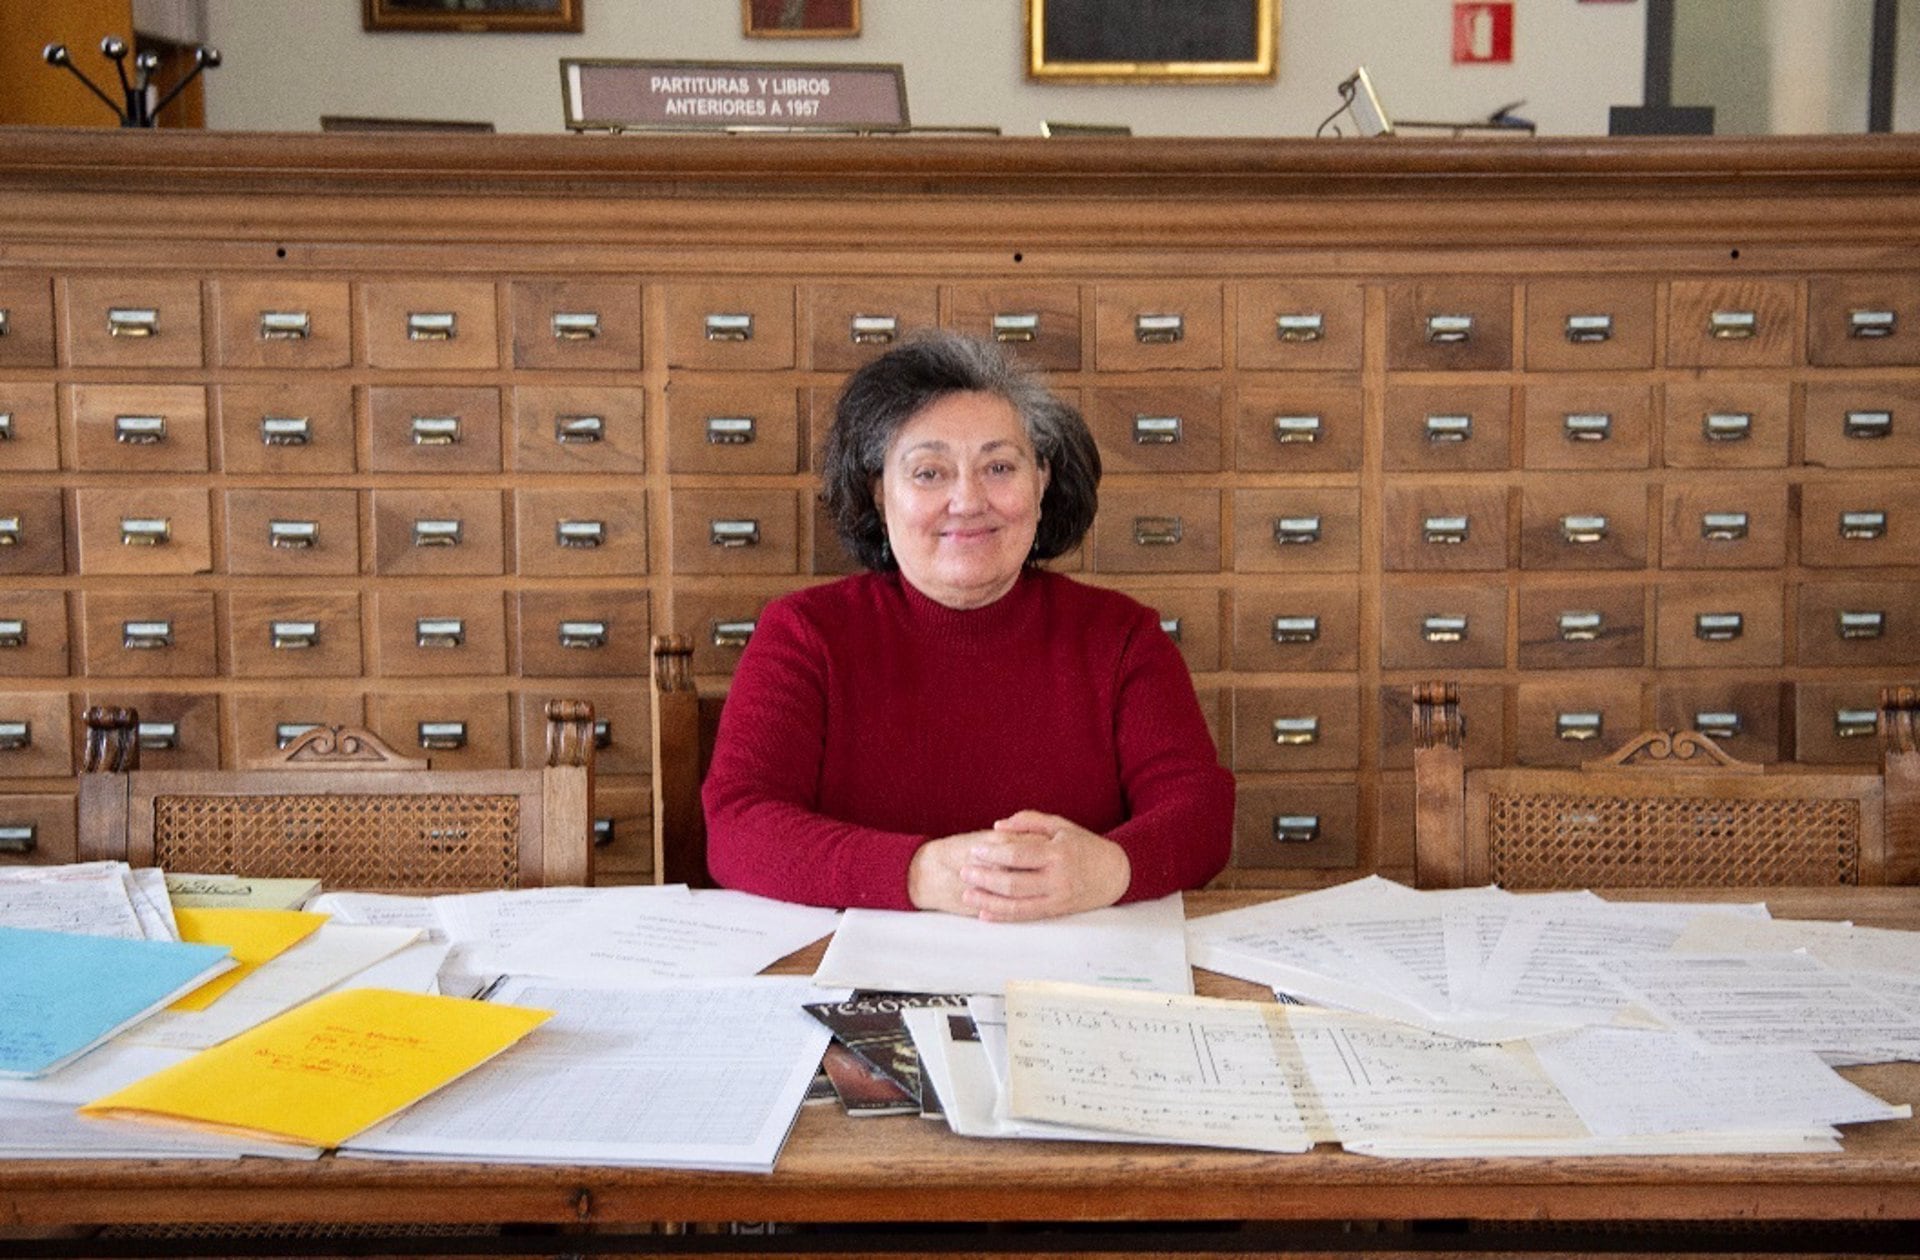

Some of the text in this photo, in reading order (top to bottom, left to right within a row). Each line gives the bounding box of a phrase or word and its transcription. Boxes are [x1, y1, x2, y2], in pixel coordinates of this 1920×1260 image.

[650, 76, 830, 95] PARTITURAS Y LIBROS
[666, 98, 766, 116] ANTERIORES
[771, 99, 782, 116] A
